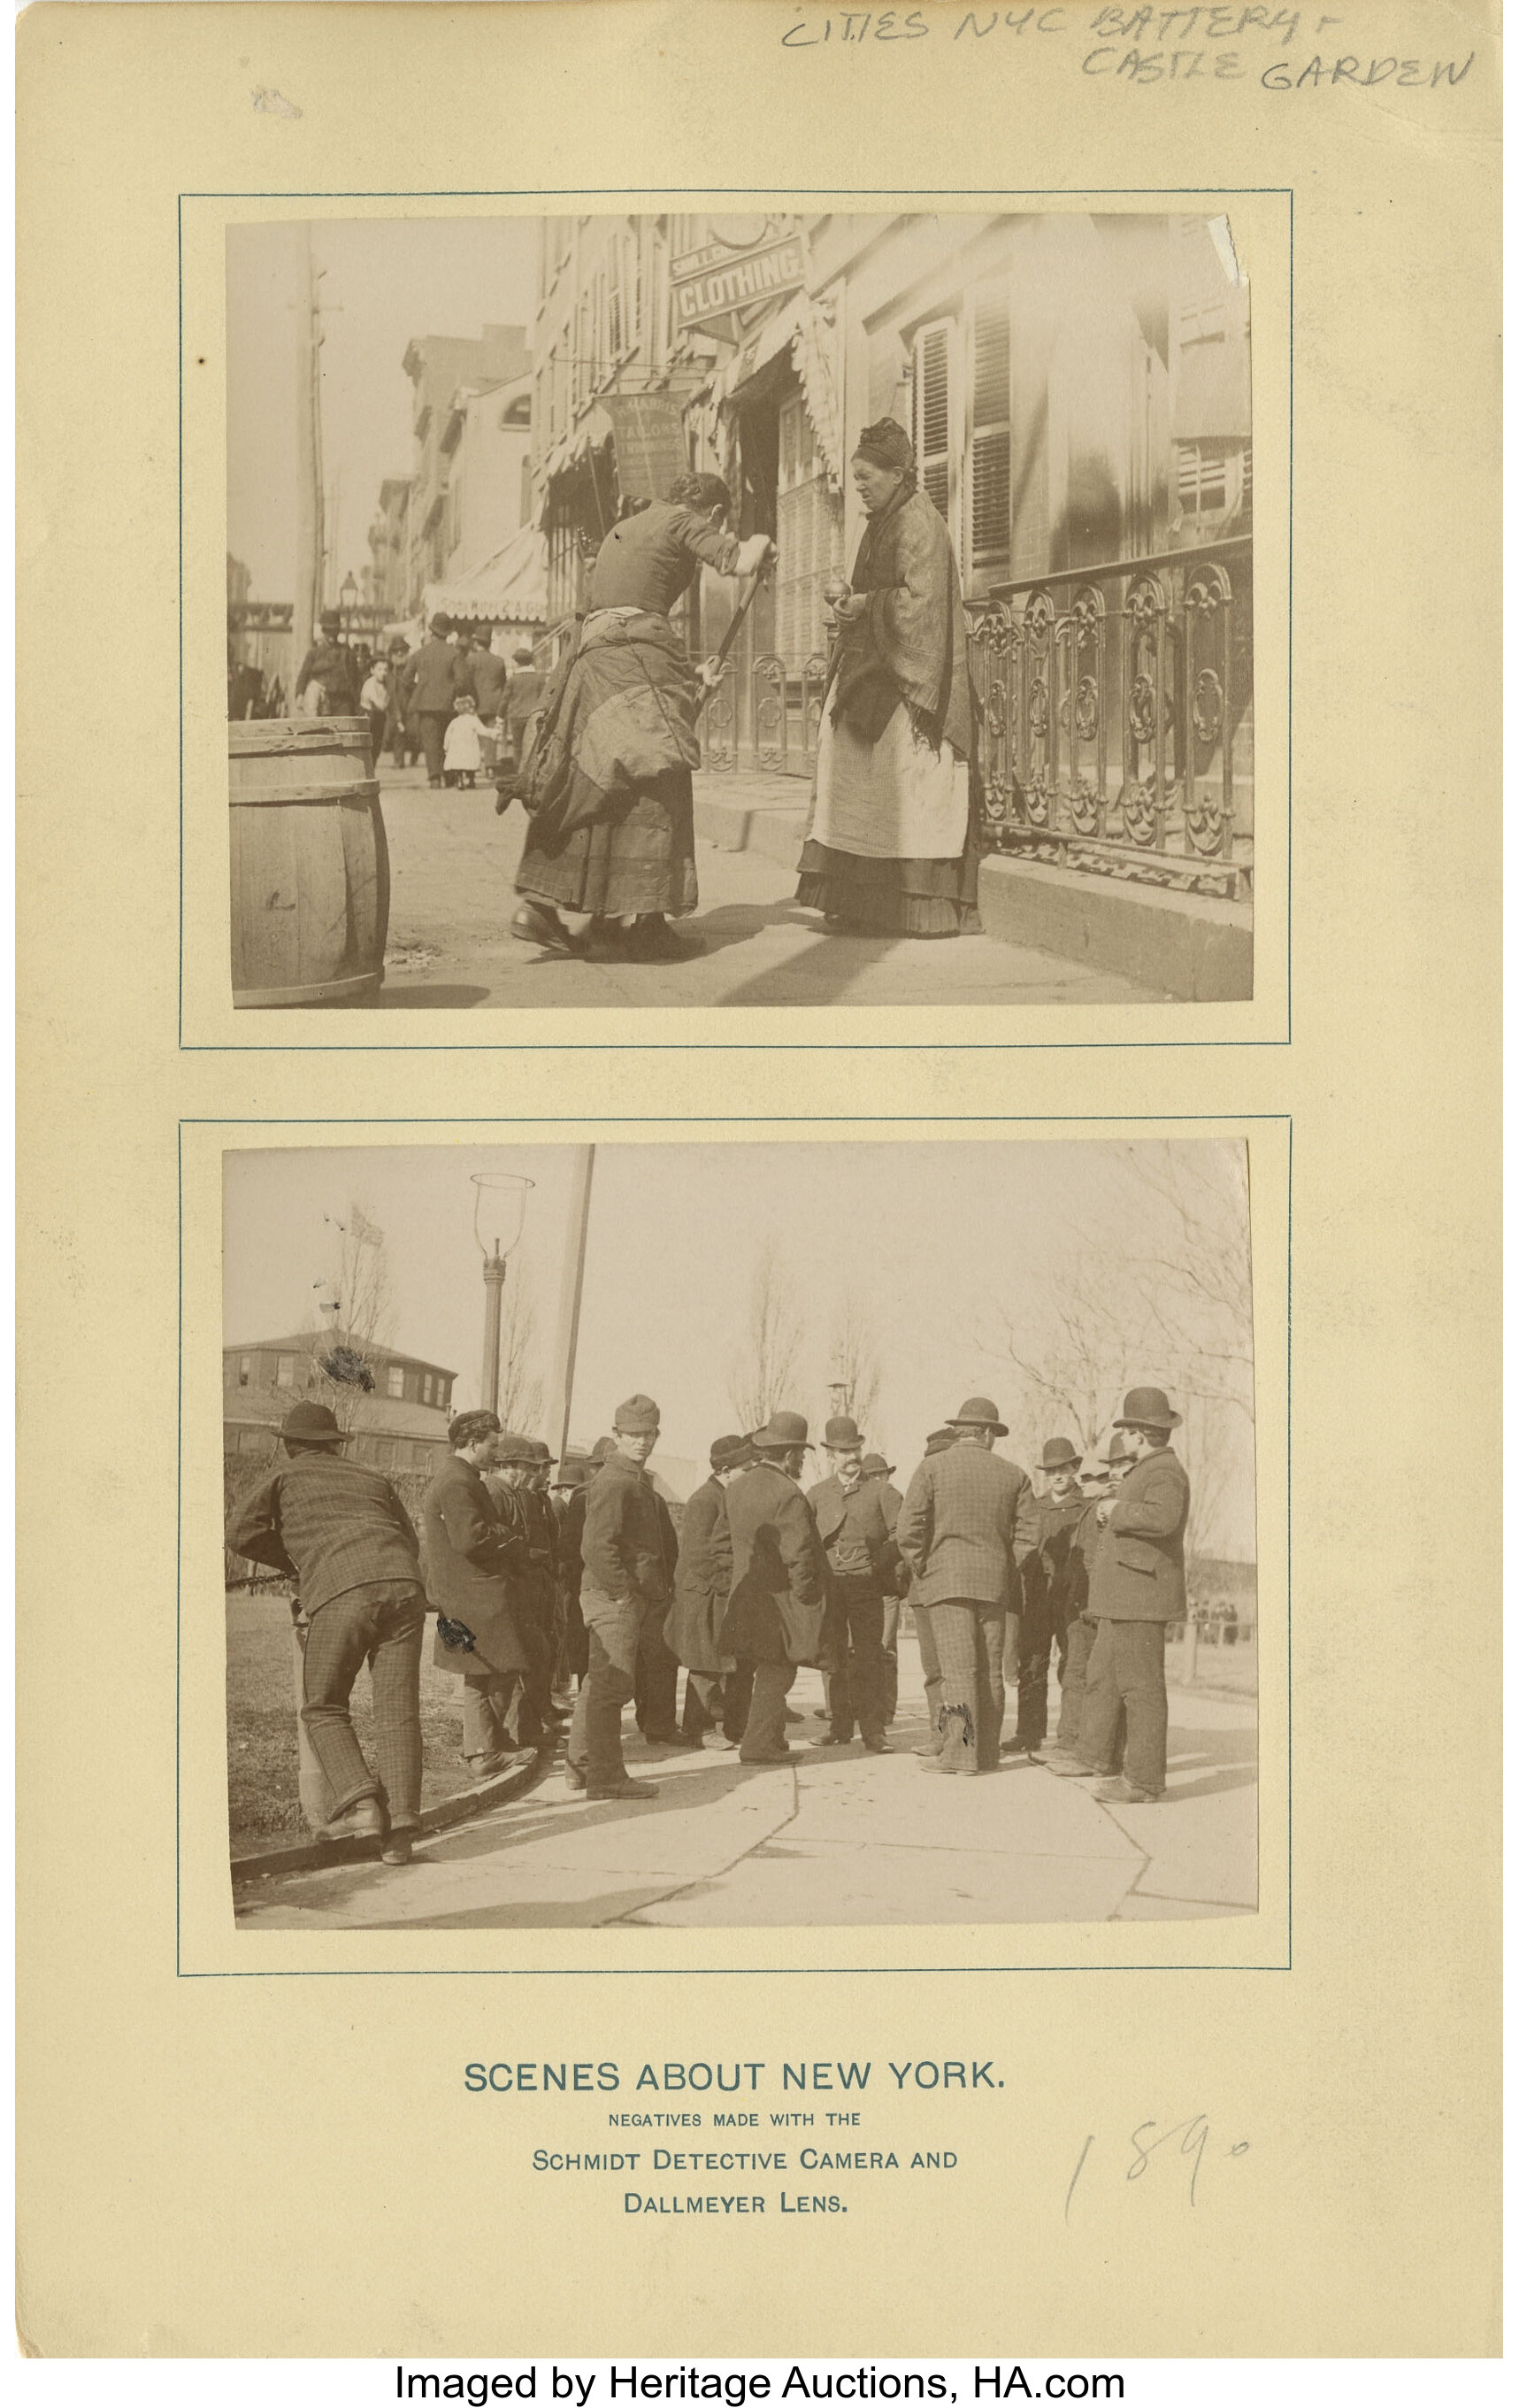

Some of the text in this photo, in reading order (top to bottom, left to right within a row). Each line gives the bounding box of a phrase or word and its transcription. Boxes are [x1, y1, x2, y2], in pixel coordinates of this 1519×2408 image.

[954, 7, 1066, 41] NYC
[1089, 4, 1301, 47] BATTERY
[1081, 47, 1476, 90] CASTLE GARDEN
[464, 2061, 1006, 2093] SCENES ABOUT NEW YORK.
[609, 2113, 862, 2128] NEGATIVES MADE WITH THE
[910, 2151, 958, 2170] AND
